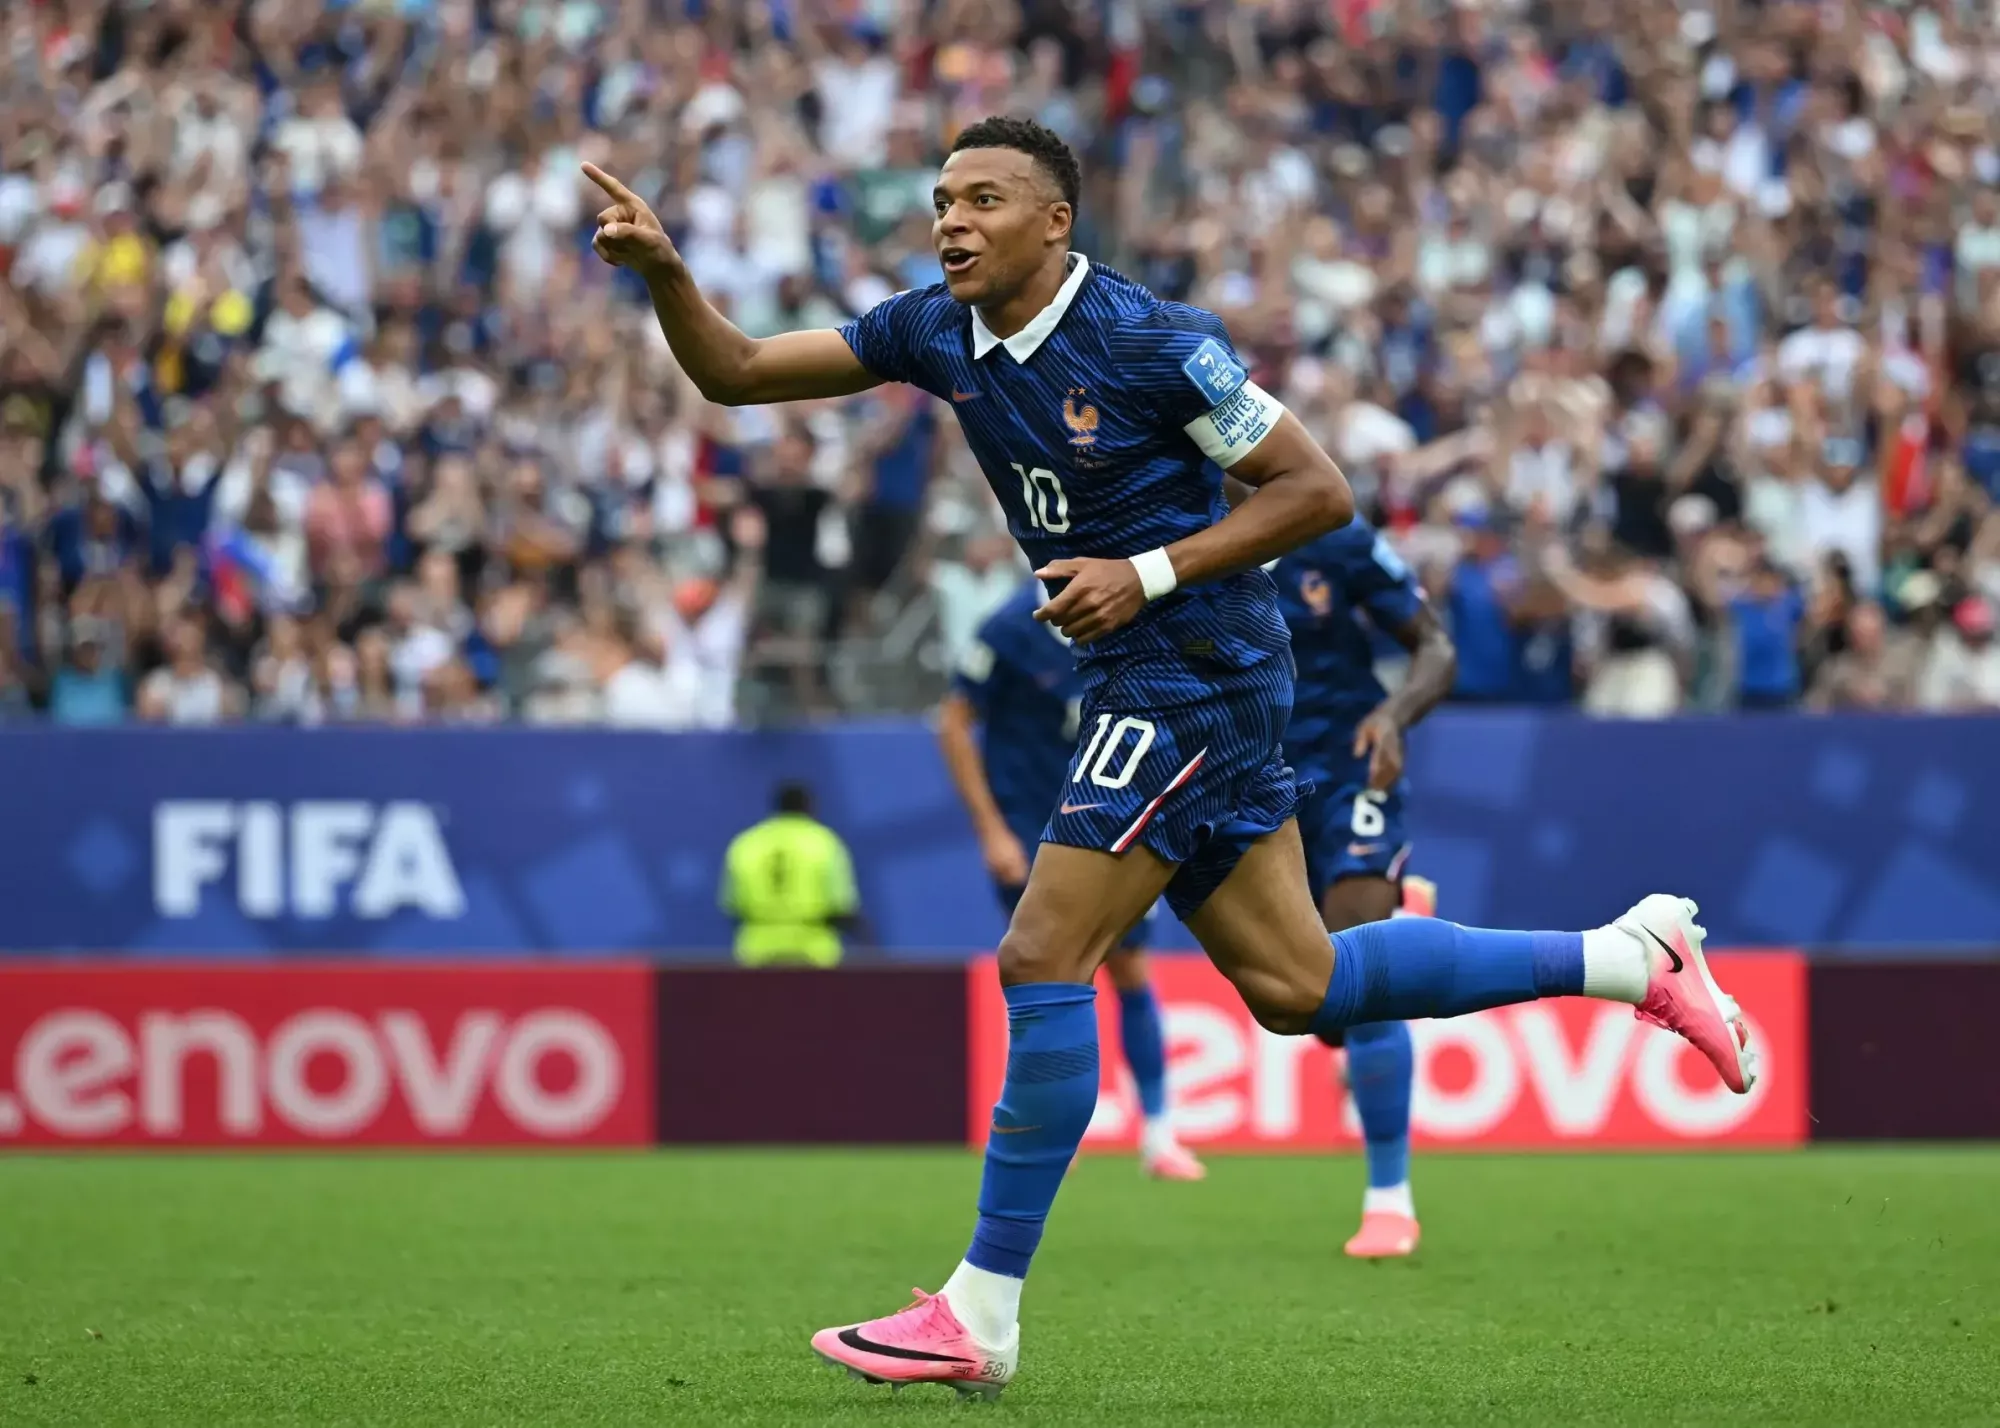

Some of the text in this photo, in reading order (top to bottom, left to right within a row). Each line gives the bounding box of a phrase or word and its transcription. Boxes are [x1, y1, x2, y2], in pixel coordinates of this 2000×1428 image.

[1213, 369, 1234, 392] PEACE
[1209, 388, 1245, 424] FOOTBALL
[1215, 394, 1255, 436] UNITES
[1223, 401, 1267, 448] the World
[1248, 423, 1267, 443] FIFA
[1010, 461, 1071, 534] 10
[1072, 713, 1156, 789] 10
[1352, 790, 1388, 837] 6
[153, 799, 468, 920] FIFA
[0, 1007, 624, 1138] enovo
